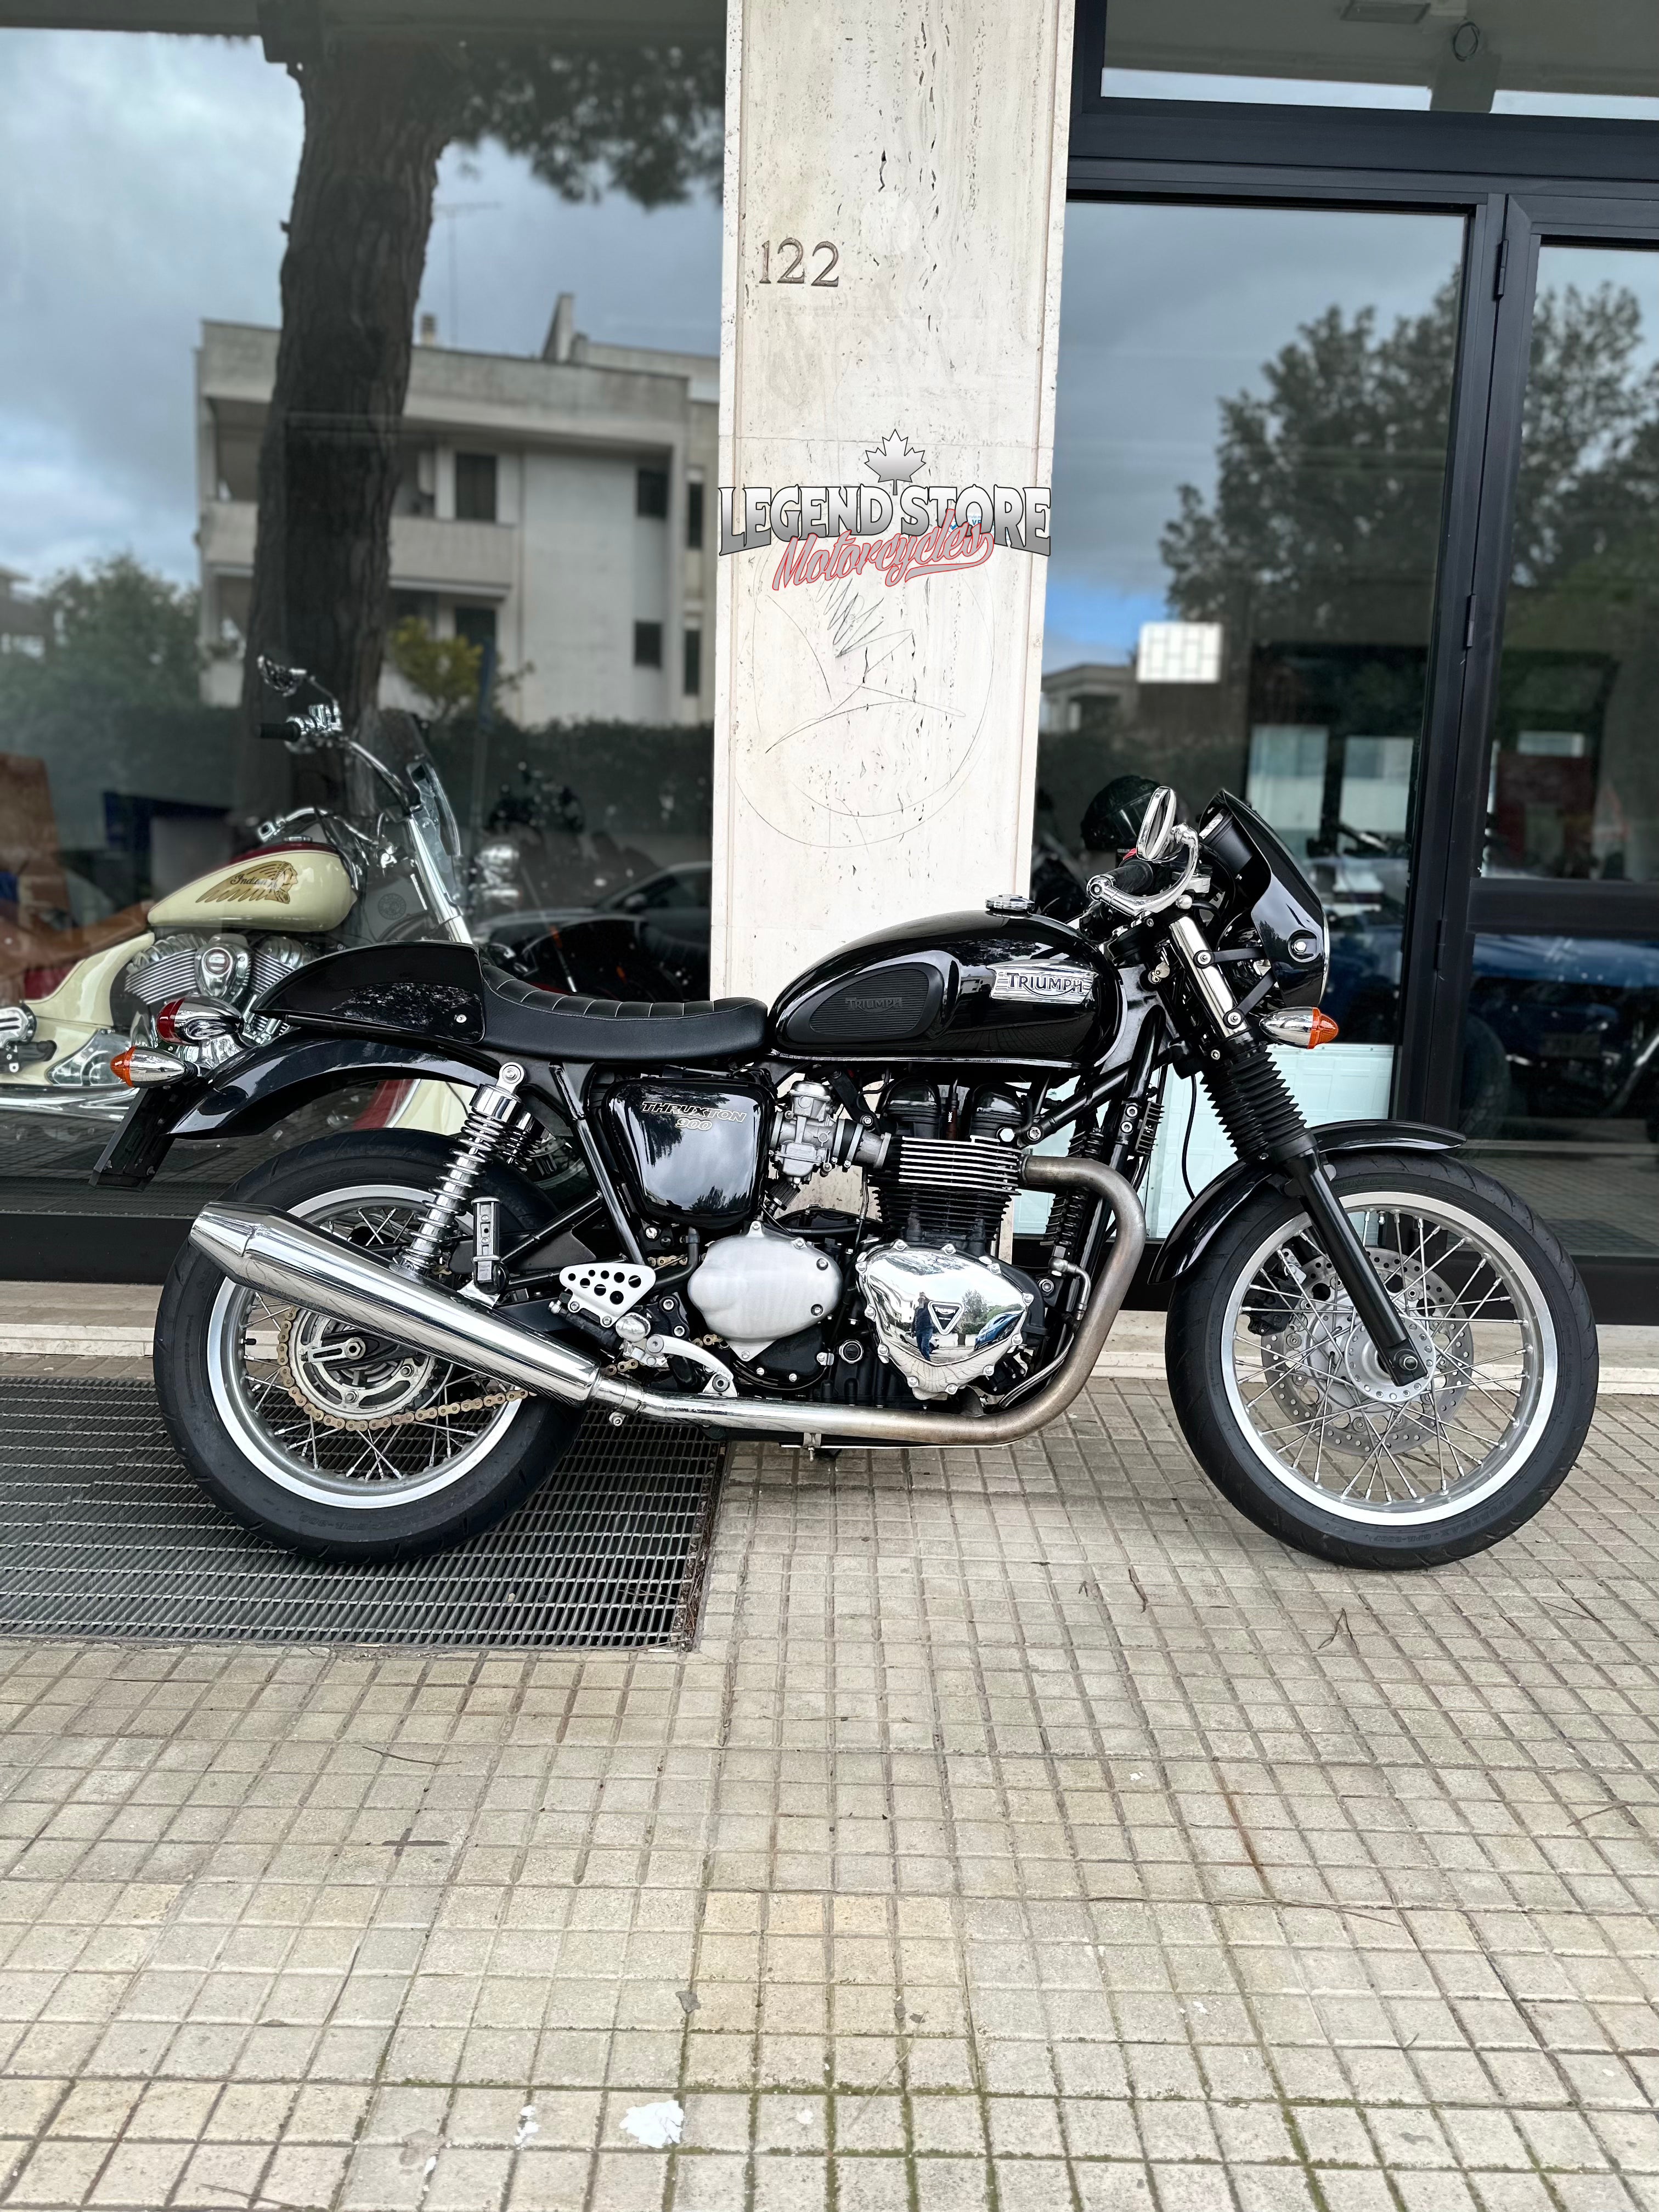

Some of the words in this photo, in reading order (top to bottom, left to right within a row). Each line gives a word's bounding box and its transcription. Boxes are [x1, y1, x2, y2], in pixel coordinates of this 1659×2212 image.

[759, 237, 839, 287] 122
[1006, 972, 1085, 995] TRIUMPH
[845, 997, 902, 1010] TRIUMPH
[641, 1101, 747, 1123] THRUXTON
[675, 1117, 712, 1131] 900
